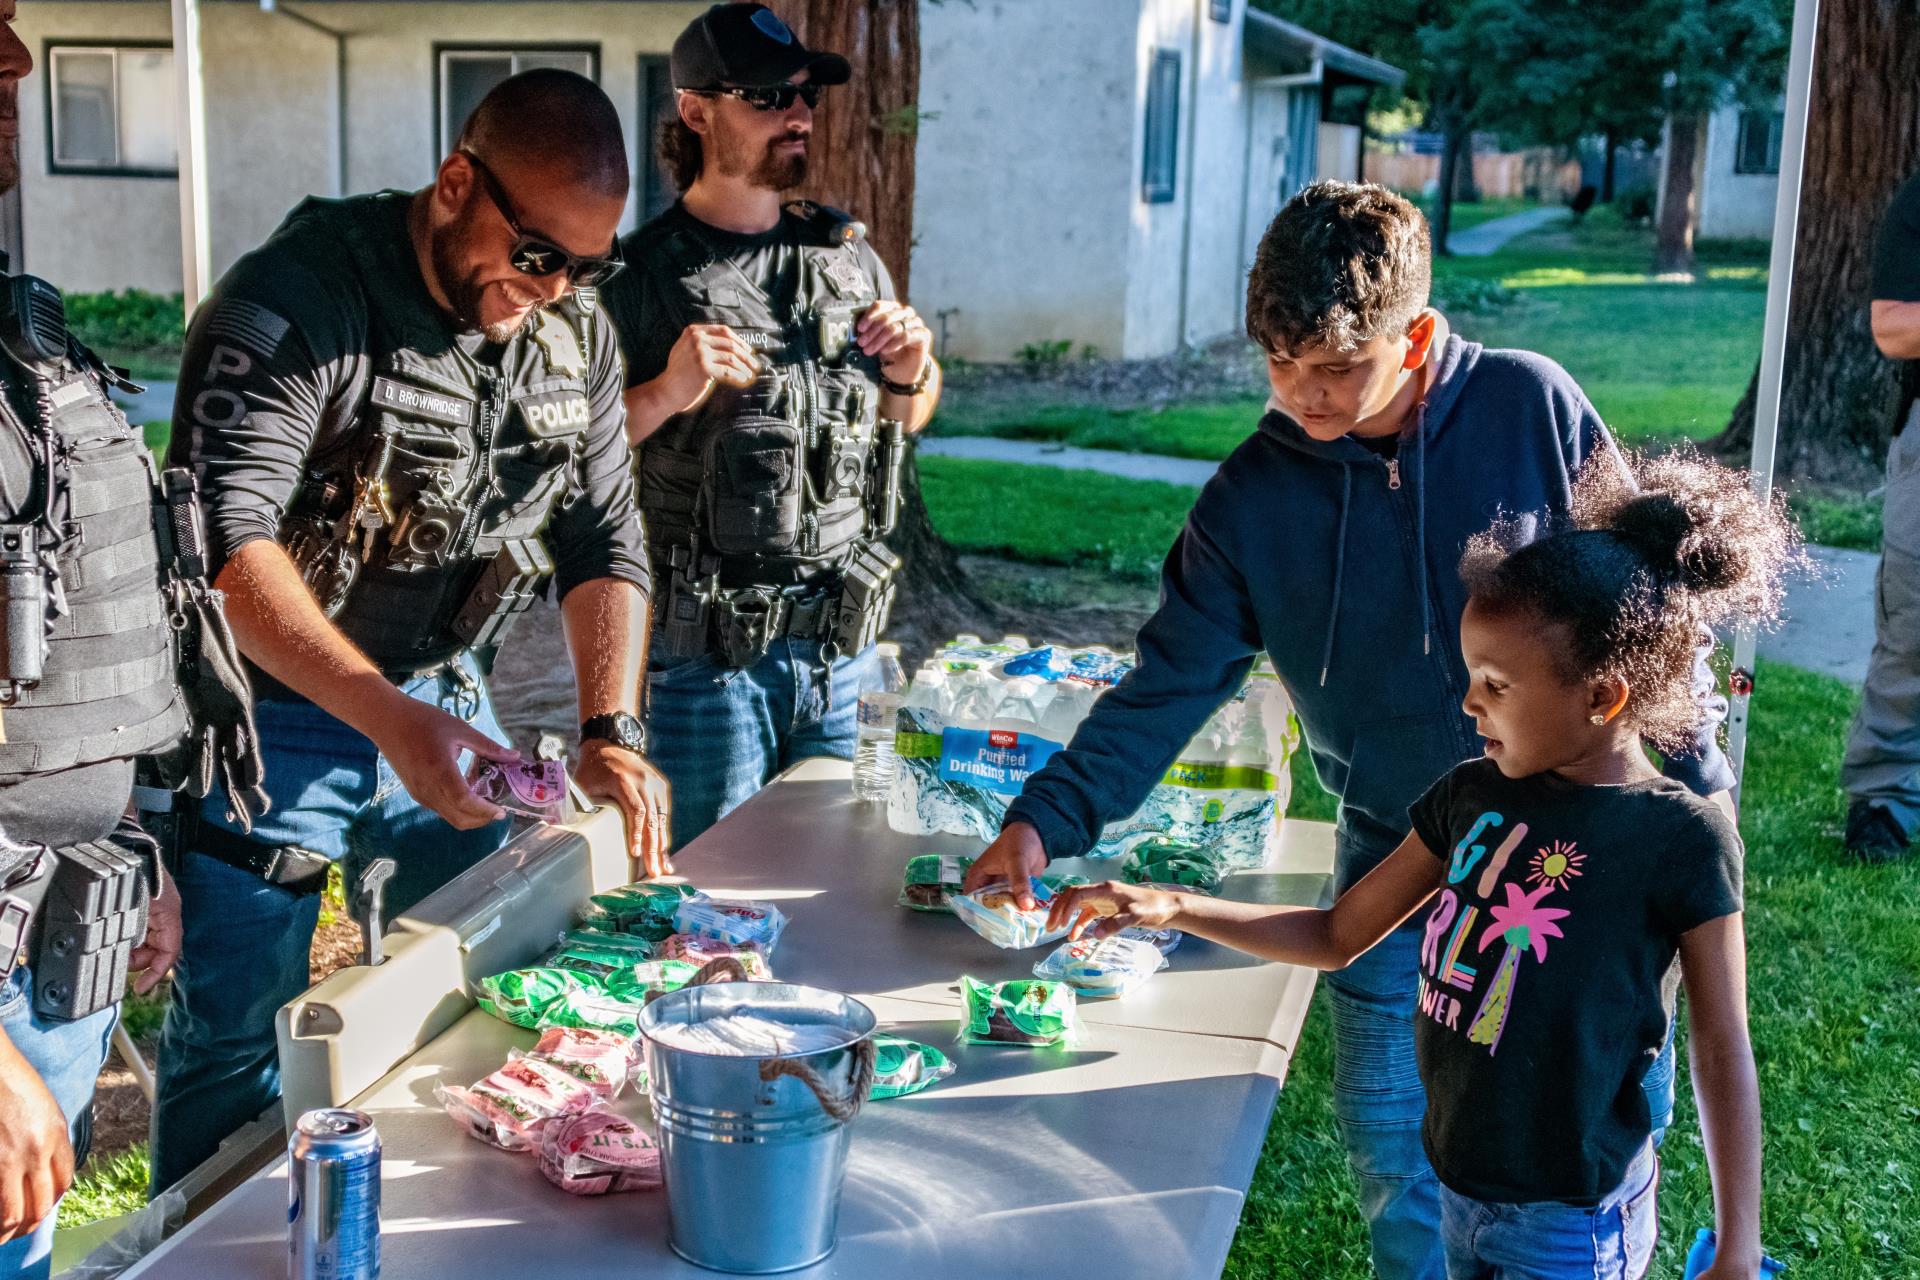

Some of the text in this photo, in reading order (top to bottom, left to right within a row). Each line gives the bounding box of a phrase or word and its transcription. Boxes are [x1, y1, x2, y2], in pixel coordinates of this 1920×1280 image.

[385, 385, 462, 417] D. BROWNRIDGE
[527, 398, 589, 431] POLICE
[977, 748, 1026, 766] Purified
[949, 759, 1005, 784] Drinking
